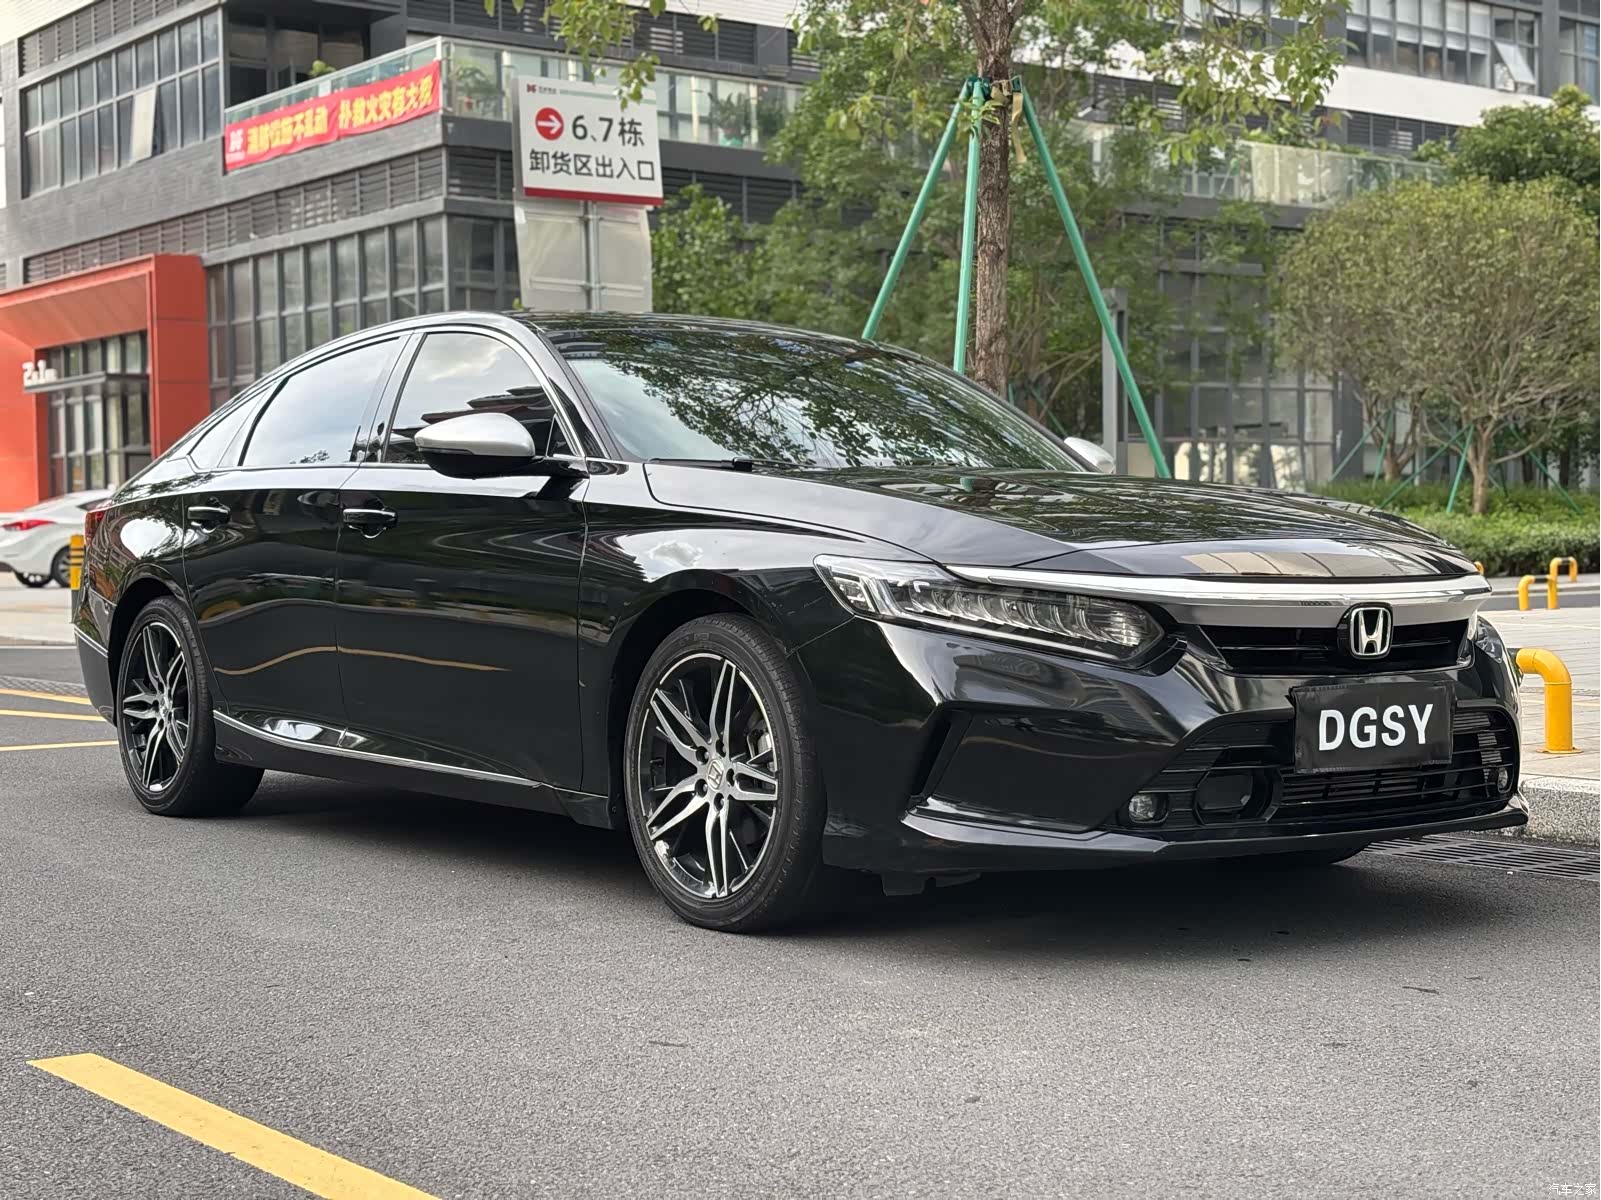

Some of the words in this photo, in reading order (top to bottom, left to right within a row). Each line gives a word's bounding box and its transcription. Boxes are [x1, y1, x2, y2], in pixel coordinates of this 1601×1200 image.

[529, 149, 656, 182] 卸货区出入口
[1318, 703, 1434, 751] DGSY
